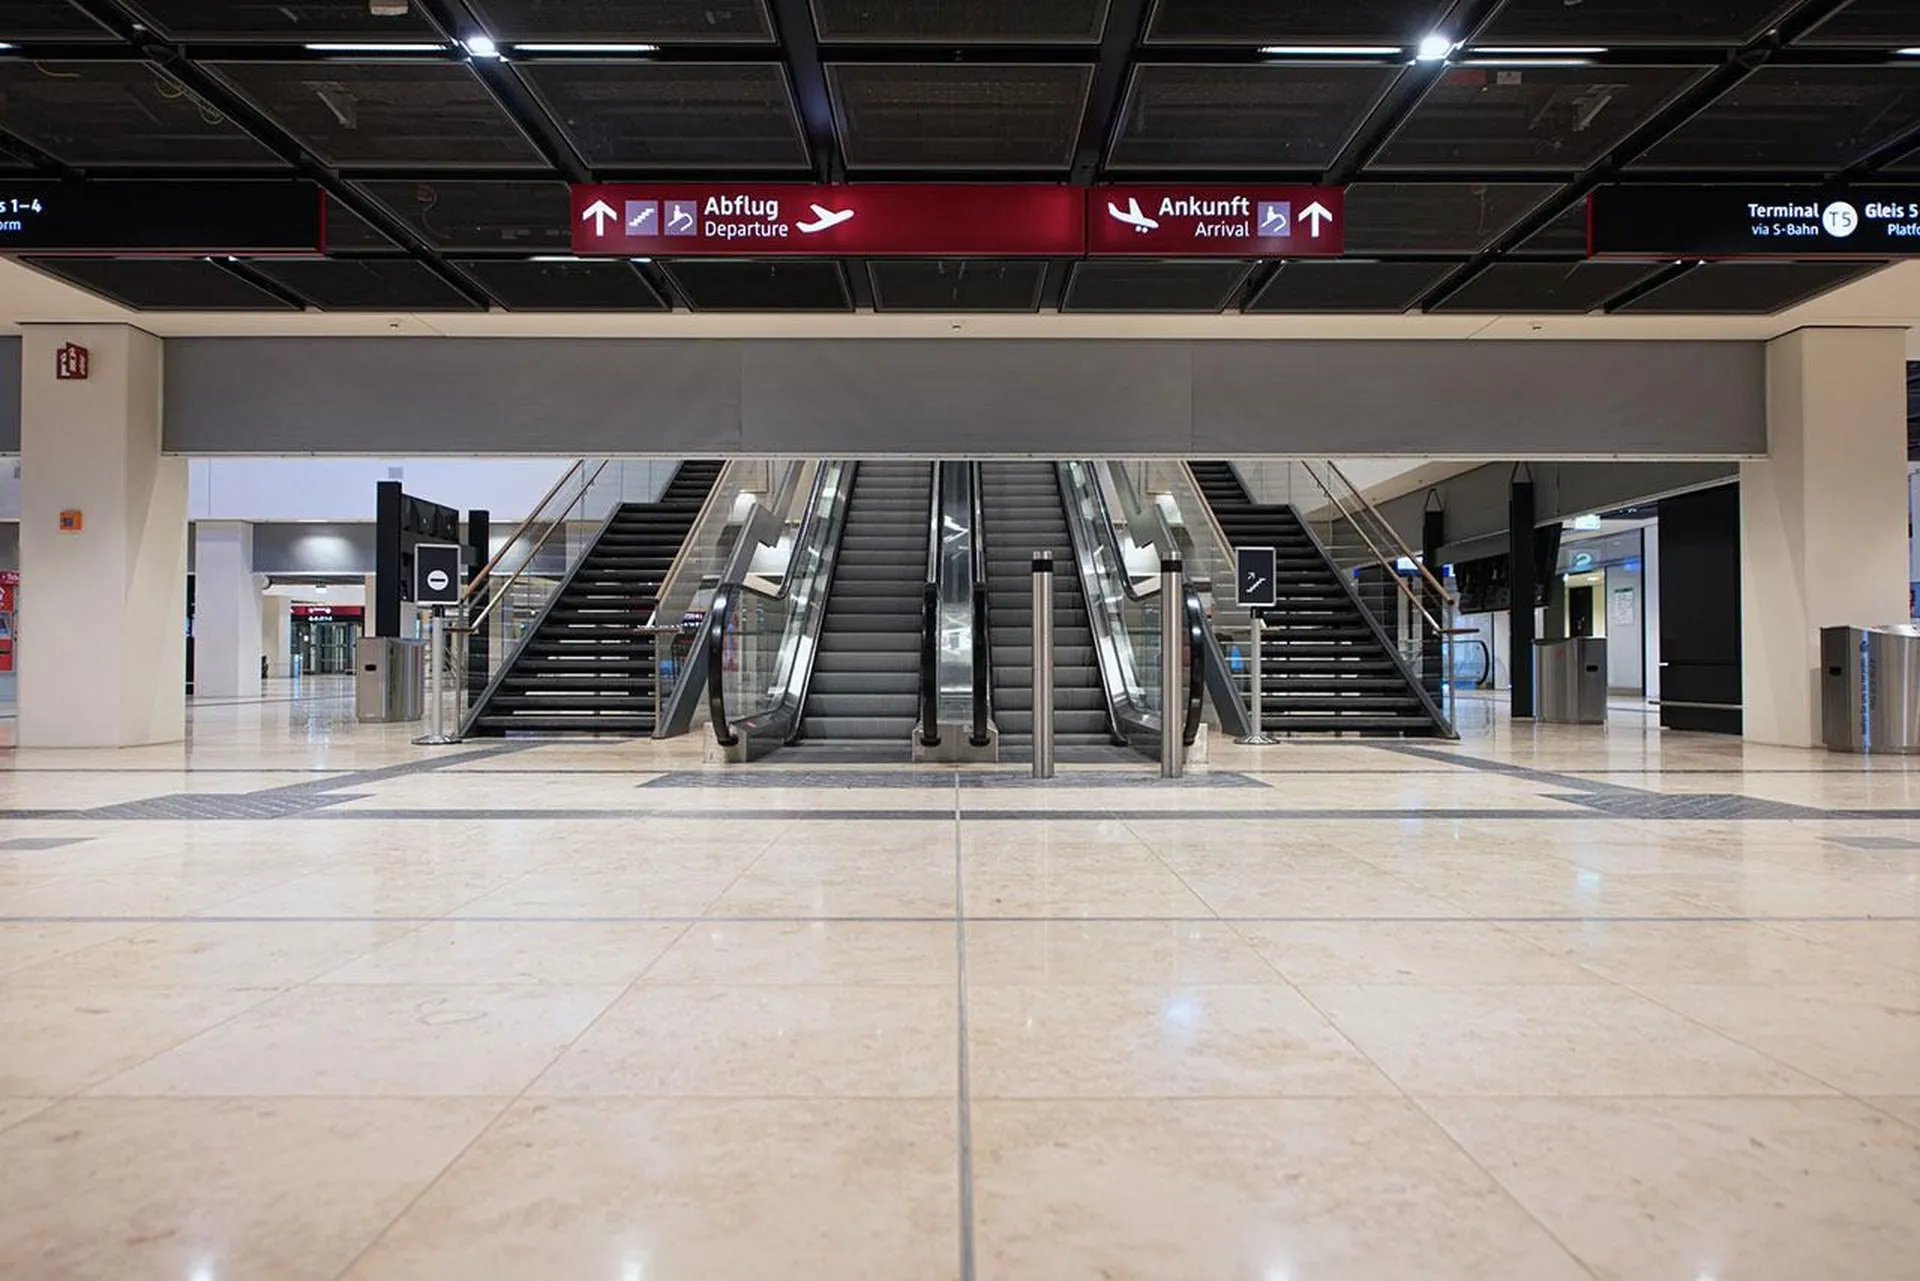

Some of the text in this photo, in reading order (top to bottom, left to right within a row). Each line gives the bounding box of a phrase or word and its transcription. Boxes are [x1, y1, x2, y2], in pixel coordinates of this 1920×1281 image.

[703, 194, 780, 221] Abflug
[1158, 195, 1250, 217] Ankunft
[1747, 202, 1820, 218] Terminal
[1864, 202, 1905, 219] Gleis
[1828, 211, 1853, 228] T5
[704, 221, 789, 240] Departure
[1194, 220, 1250, 238] Arrival
[1751, 222, 1819, 236] via S-Bahn
